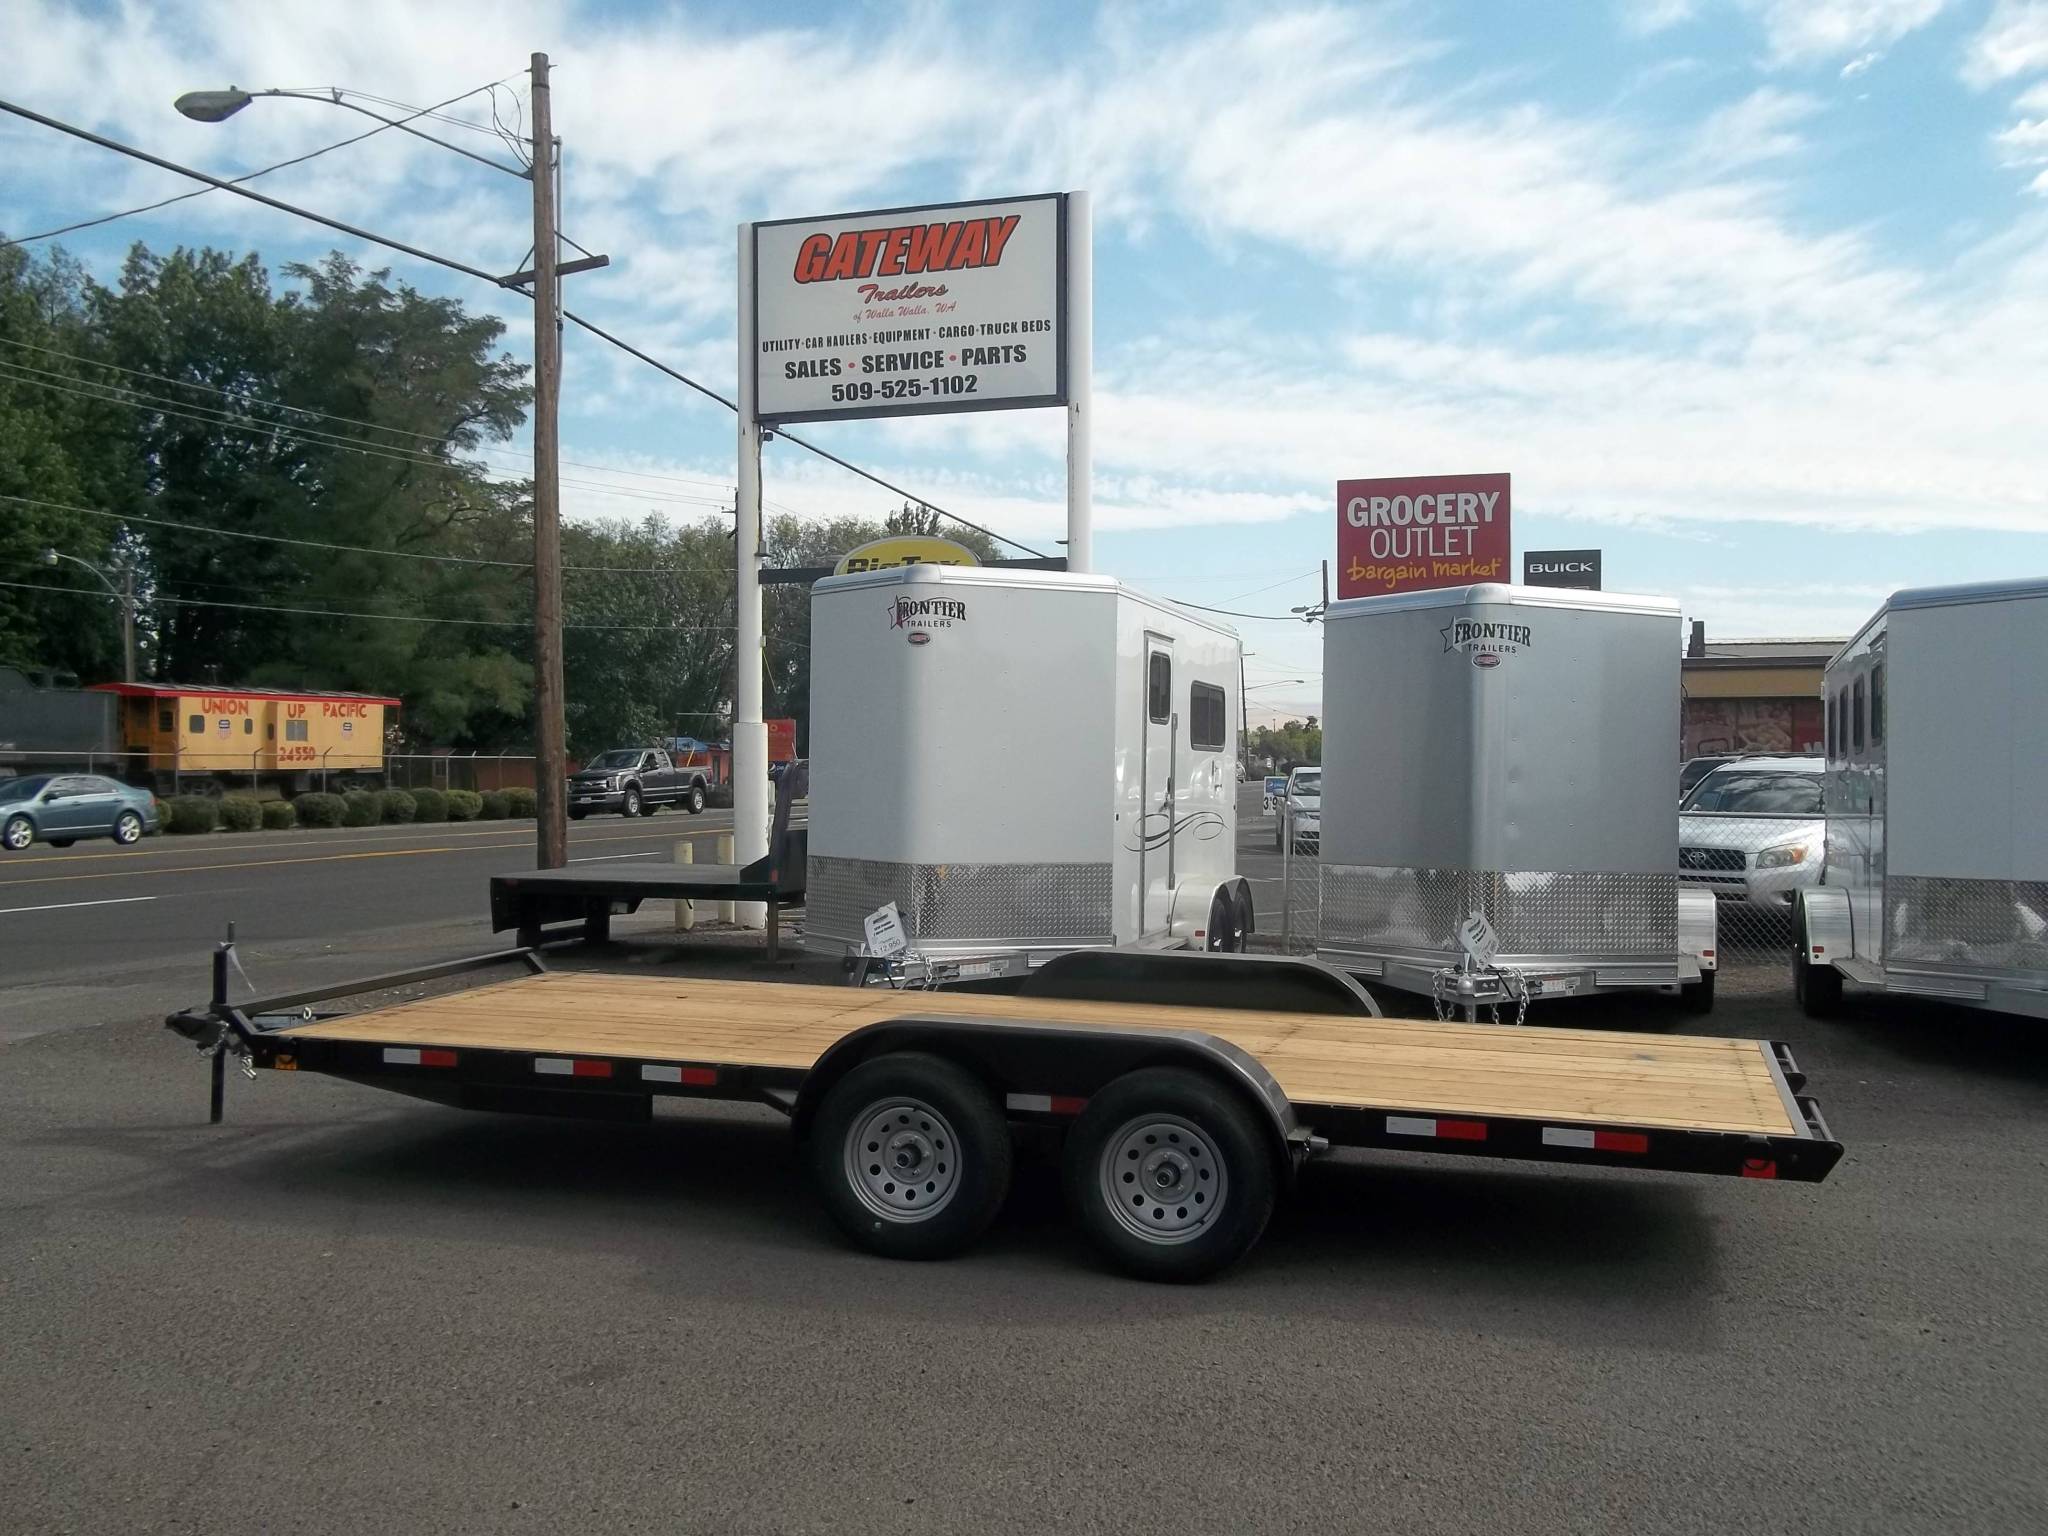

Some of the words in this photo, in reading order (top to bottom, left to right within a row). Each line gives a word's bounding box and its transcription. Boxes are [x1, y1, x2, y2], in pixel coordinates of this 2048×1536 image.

[793, 215, 1022, 284] GATEWAY
[857, 281, 949, 304] Trailers
[852, 310, 863, 323] of
[865, 308, 894, 319] Walla
[935, 301, 957, 313] WA
[762, 338, 801, 353] UTILITY
[805, 337, 824, 349] CAR
[827, 332, 868, 347] HAULERS
[873, 328, 931, 345] EQUIPMENT
[938, 324, 975, 339] CARGO
[980, 321, 1018, 336] TRUCK
[1021, 319, 1051, 333] BEDS
[785, 358, 842, 379] SALES
[862, 350, 945, 374] SERVICE
[961, 344, 1027, 366] PARTS
[832, 375, 978, 402] 509-525-1102
[1347, 491, 1500, 527] GROCERY
[1370, 525, 1479, 559] OUTLET
[1347, 556, 1427, 588] bargain
[1432, 557, 1501, 577] market
[1529, 562, 1594, 574] BUICK
[897, 600, 967, 621] FRONTIER
[907, 620, 952, 628] TRAILERS
[1454, 622, 1531, 647] FRONTIER
[1468, 643, 1517, 654] TRAILERS
[201, 698, 249, 715] UNION
[287, 703, 306, 718] UP
[322, 702, 367, 718] PACIFIC
